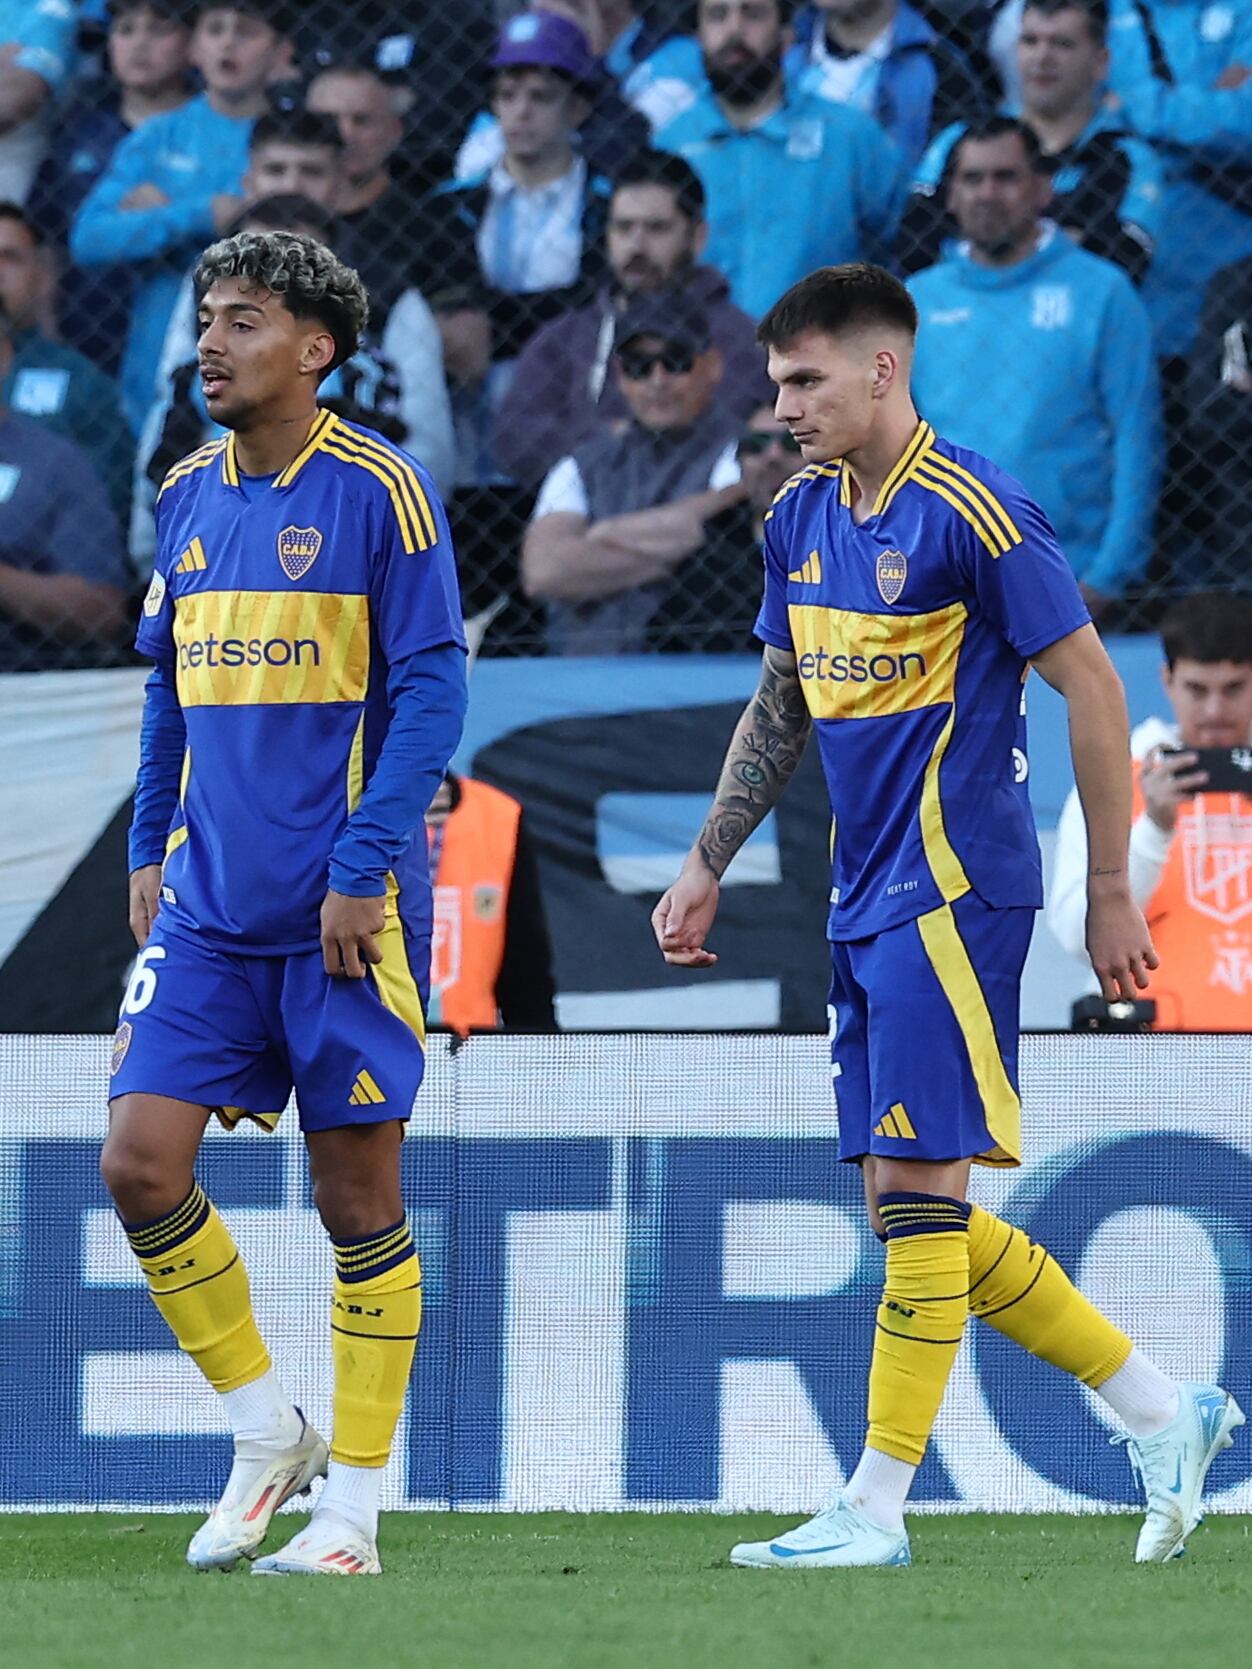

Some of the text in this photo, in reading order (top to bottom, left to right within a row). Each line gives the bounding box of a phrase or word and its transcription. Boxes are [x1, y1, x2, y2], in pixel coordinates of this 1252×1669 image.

[283, 543, 314, 557] CABJ
[179, 632, 320, 671] betsson
[799, 646, 927, 683] etsson
[118, 946, 166, 1019] 6
